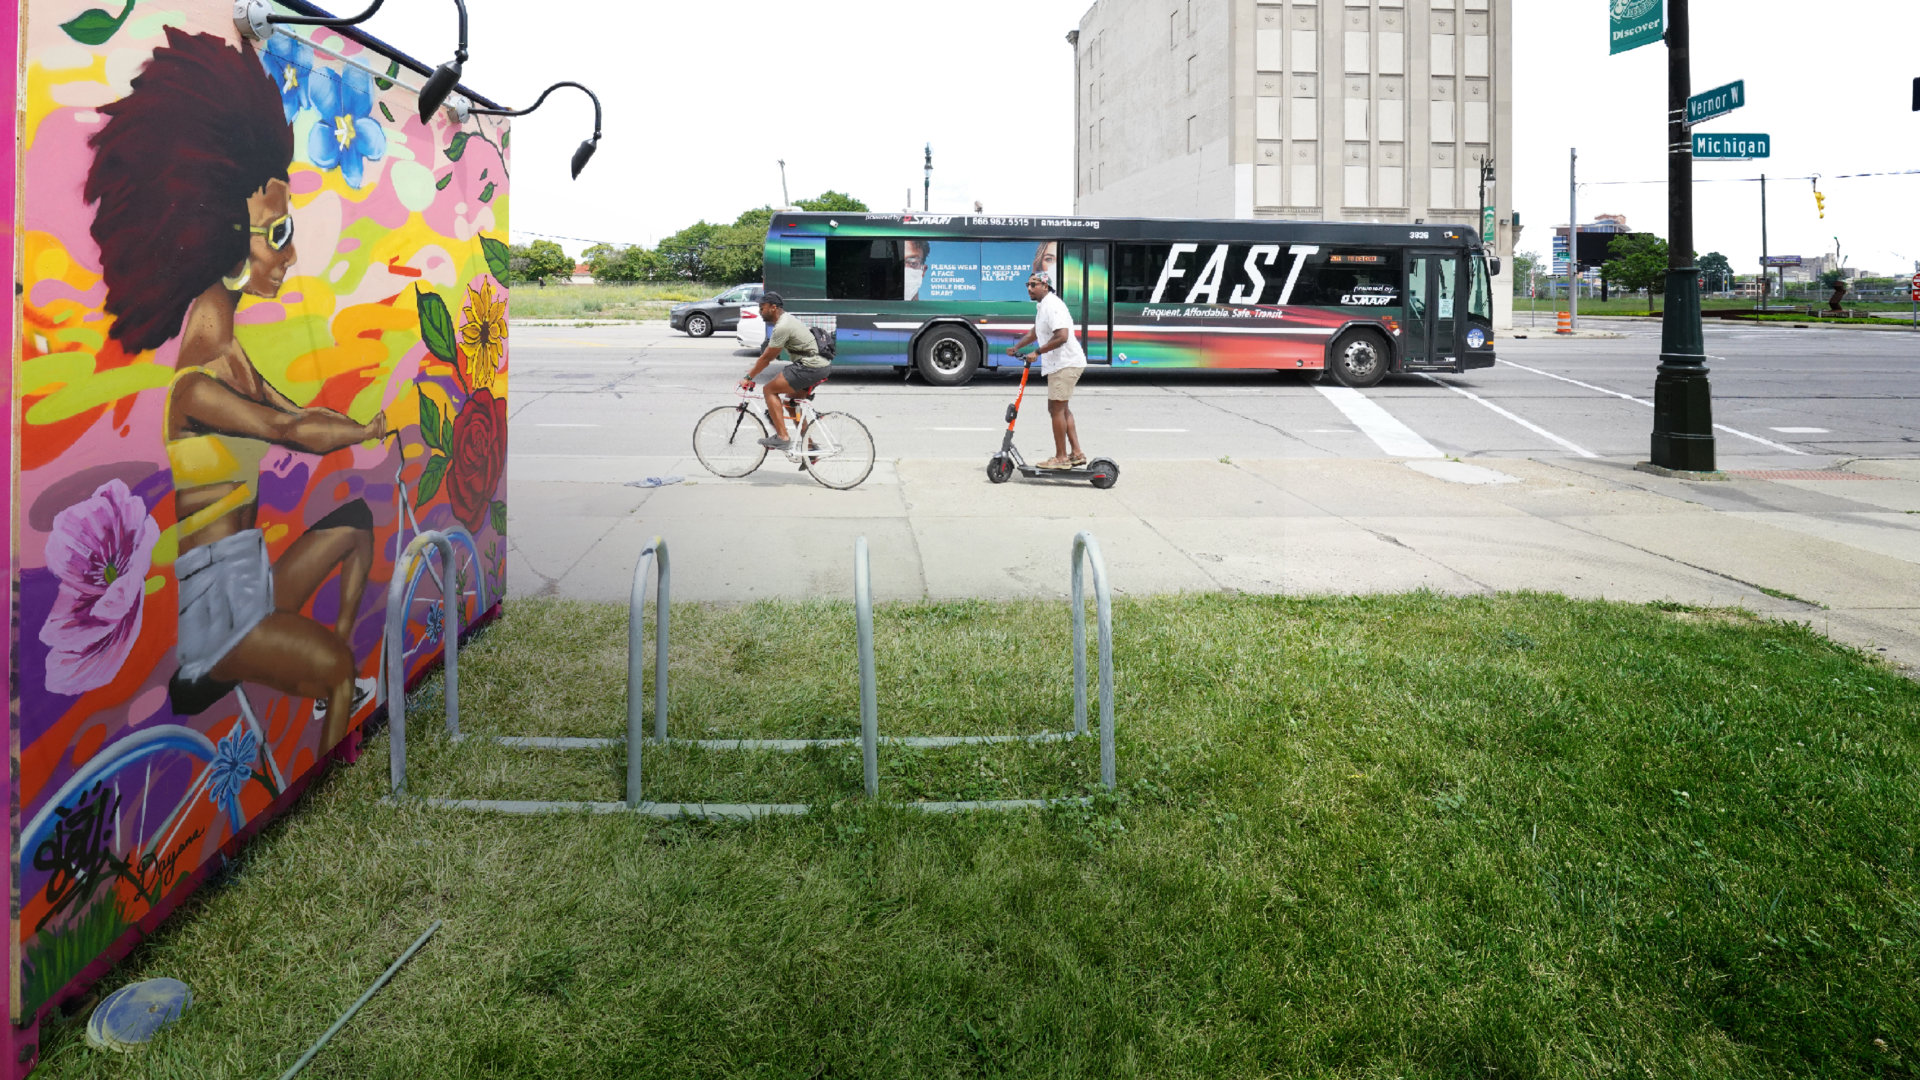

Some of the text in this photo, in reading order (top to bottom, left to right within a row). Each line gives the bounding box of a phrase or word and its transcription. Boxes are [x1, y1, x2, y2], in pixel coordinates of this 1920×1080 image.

[1612, 18, 1660, 41] Discover
[1691, 86, 1739, 117] Vernor W
[1697, 137, 1766, 157] Michigan
[1040, 218, 1100, 229] smartbus.org
[1150, 243, 1320, 306] FAST
[1351, 294, 1397, 305] SMART
[1142, 307, 1284, 321] Frequent. Affordable. Safe. Transit.
